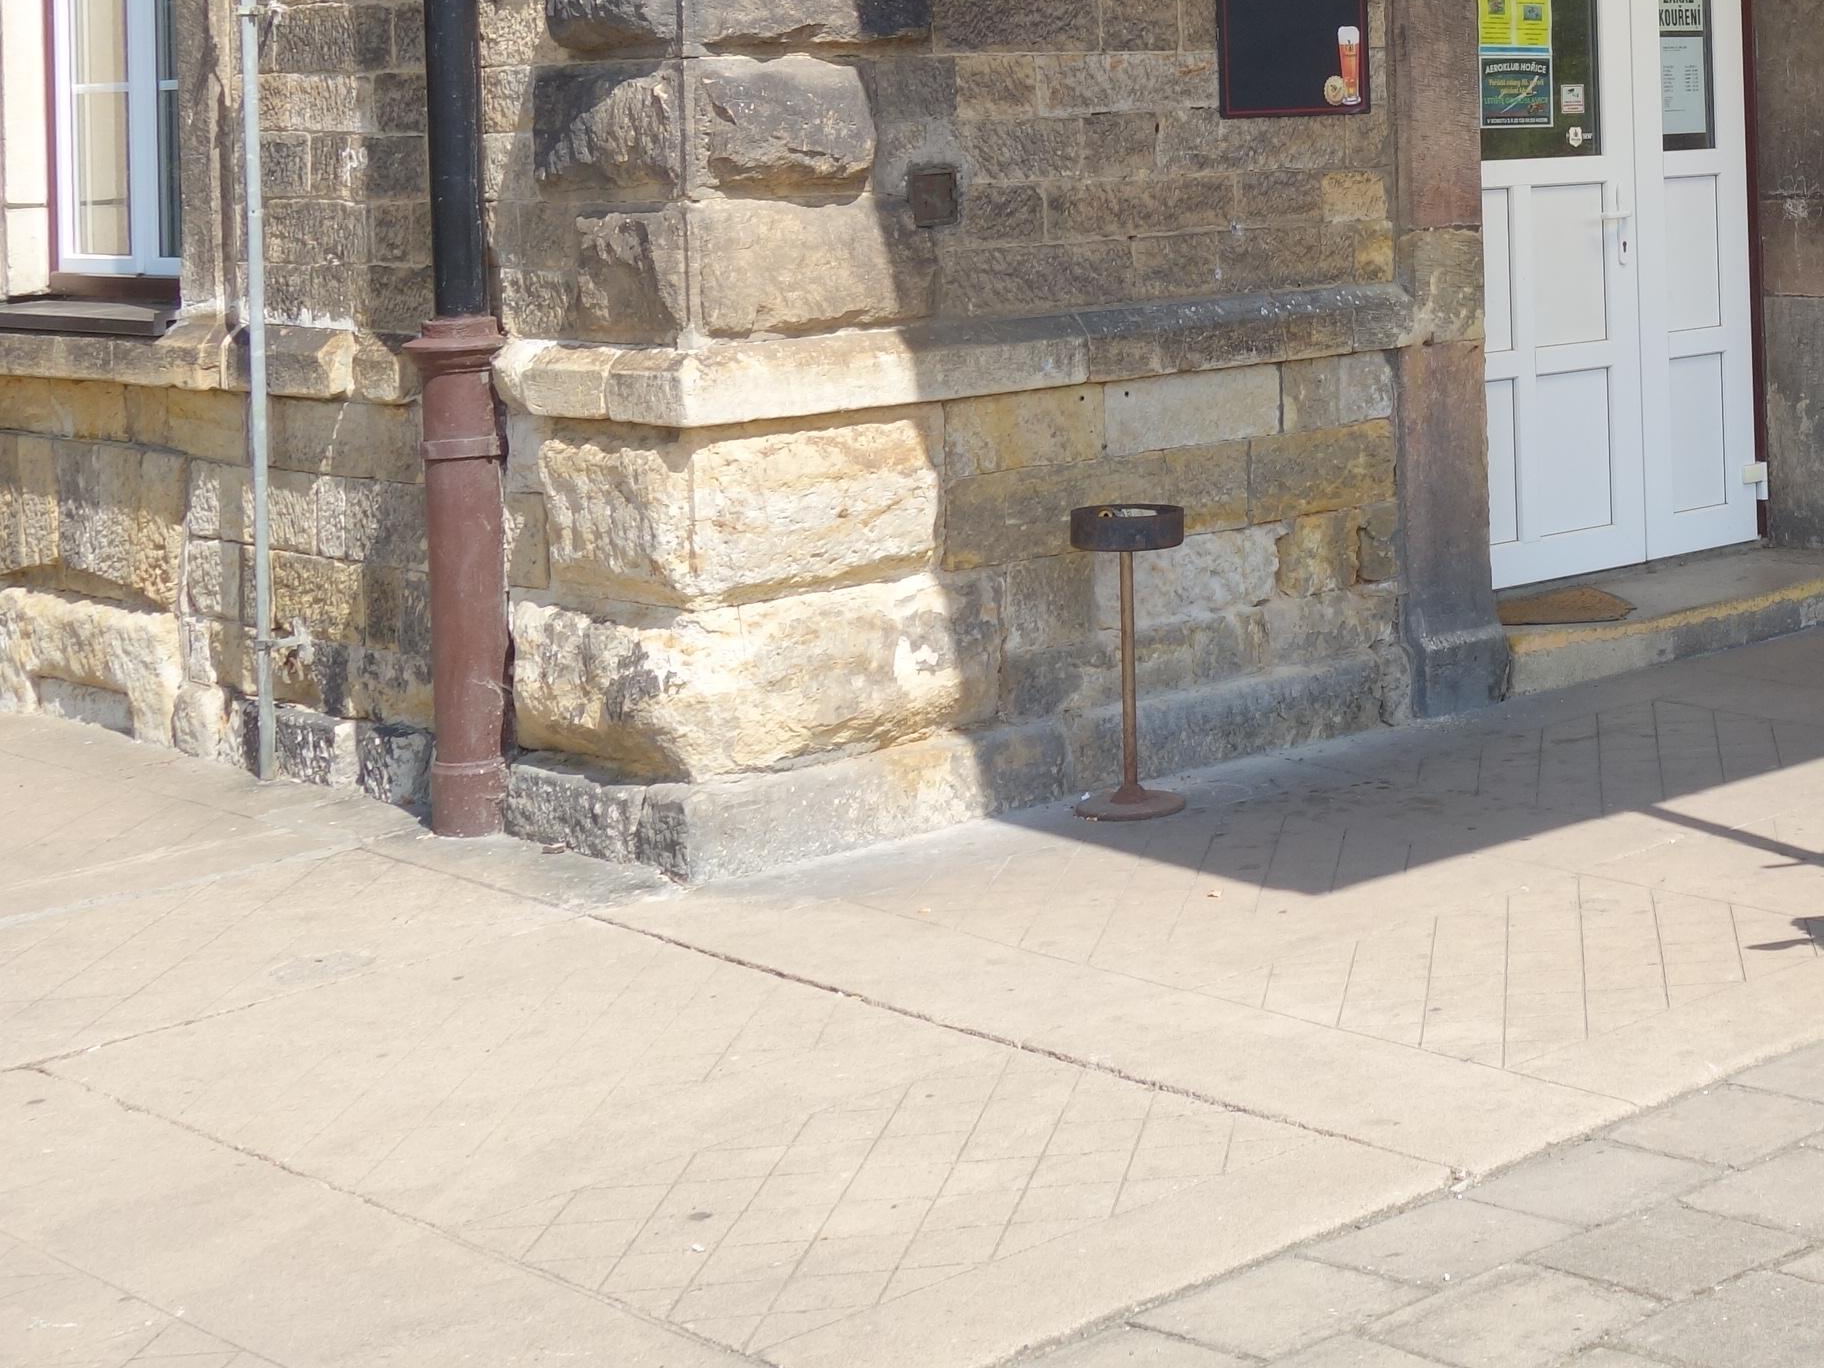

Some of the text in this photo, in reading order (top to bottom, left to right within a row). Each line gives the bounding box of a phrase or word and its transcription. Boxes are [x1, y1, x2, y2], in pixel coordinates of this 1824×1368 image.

[1659, 4, 1701, 27] KOUŘENÍ
[1485, 61, 1547, 74] AEROKLUB HOŘICE
